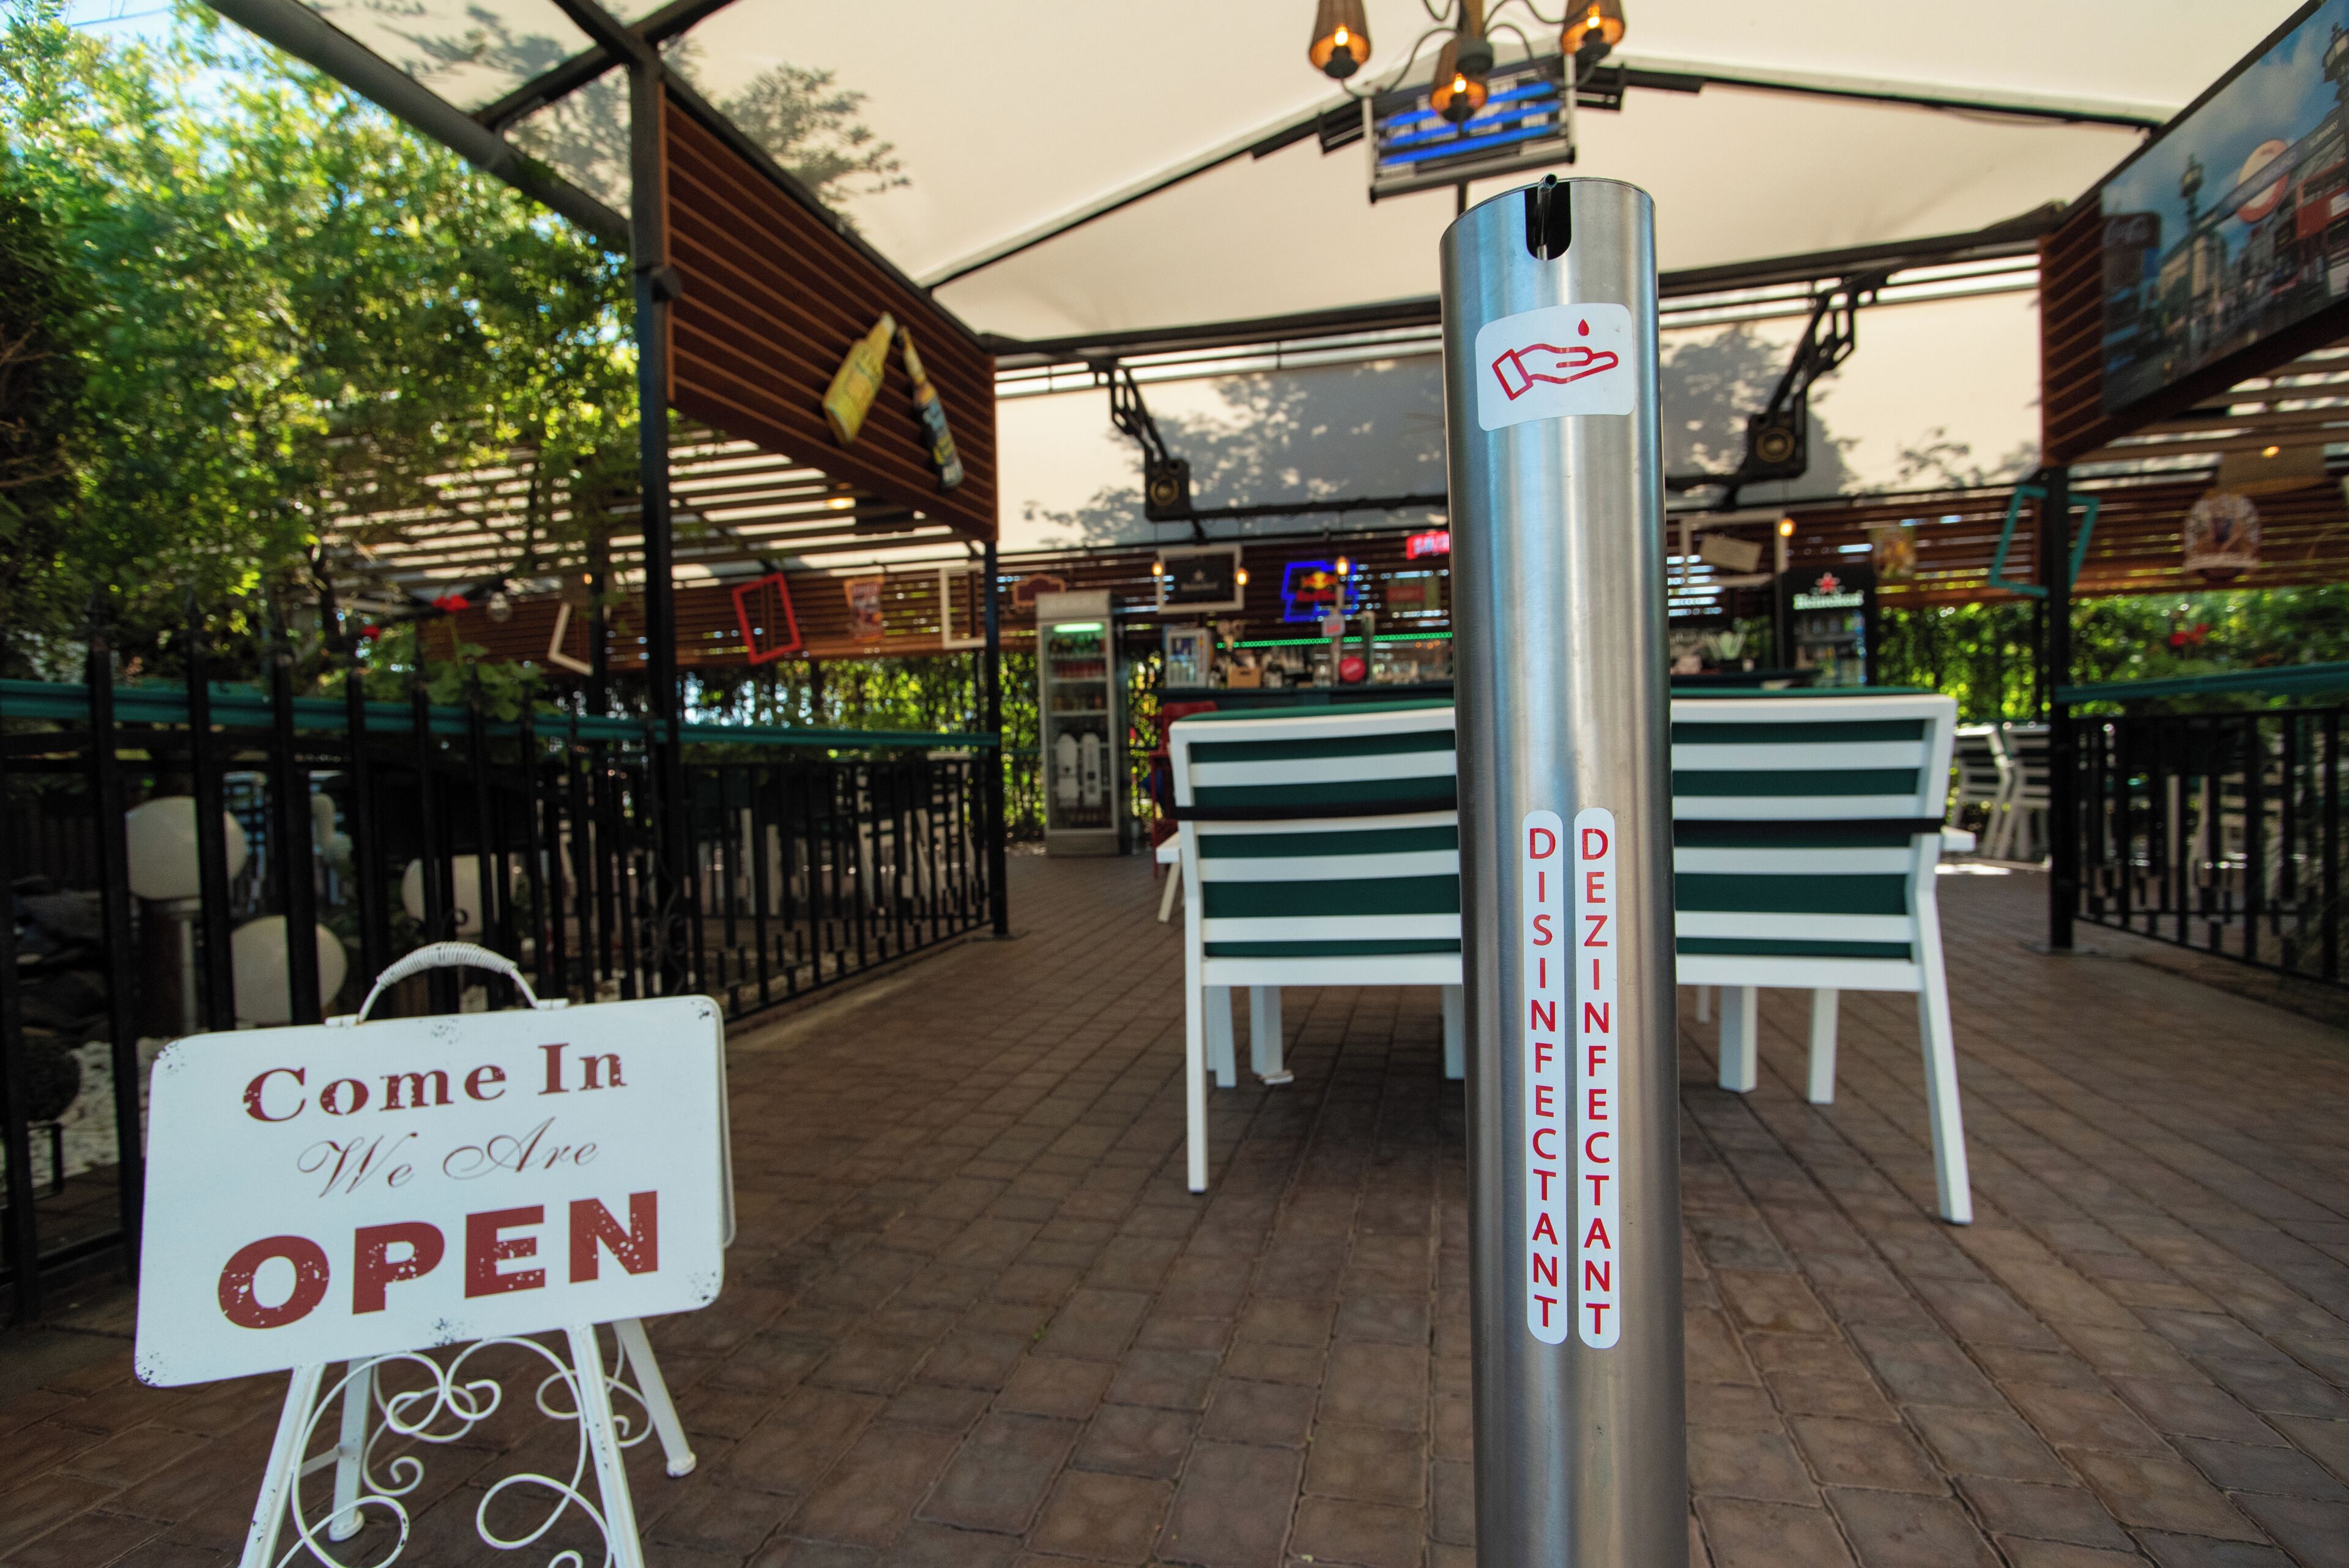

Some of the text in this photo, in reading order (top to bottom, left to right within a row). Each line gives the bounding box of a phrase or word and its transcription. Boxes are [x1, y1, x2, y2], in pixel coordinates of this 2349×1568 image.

[242, 1043, 627, 1123] Come In
[1529, 828, 1559, 1328] DISINFECTANT
[1582, 828, 1611, 1336] DEZINFECTANT
[296, 1116, 600, 1200] We Are
[217, 1191, 659, 1330] OPEN
